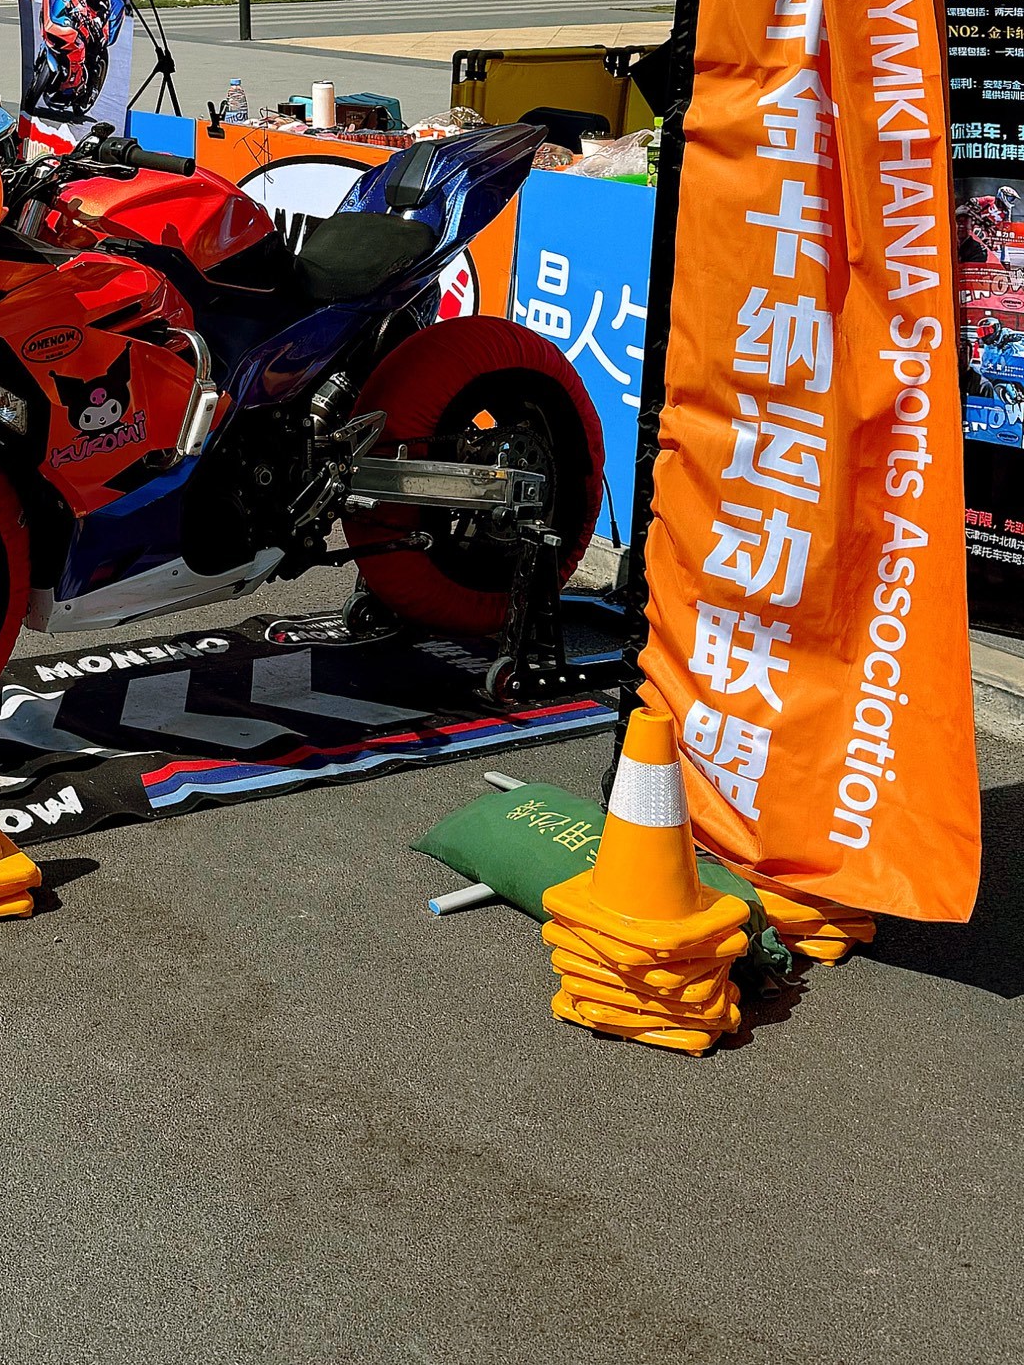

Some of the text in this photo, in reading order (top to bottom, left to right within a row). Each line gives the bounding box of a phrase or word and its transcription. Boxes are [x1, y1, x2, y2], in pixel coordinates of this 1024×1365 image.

[29, 330, 75, 352] ONENOW
[879, 315, 943, 500] Sports
[34, 637, 230, 683] ONENOW
[828, 510, 930, 850] Association
[506, 799, 603, 869] 用沙袋
